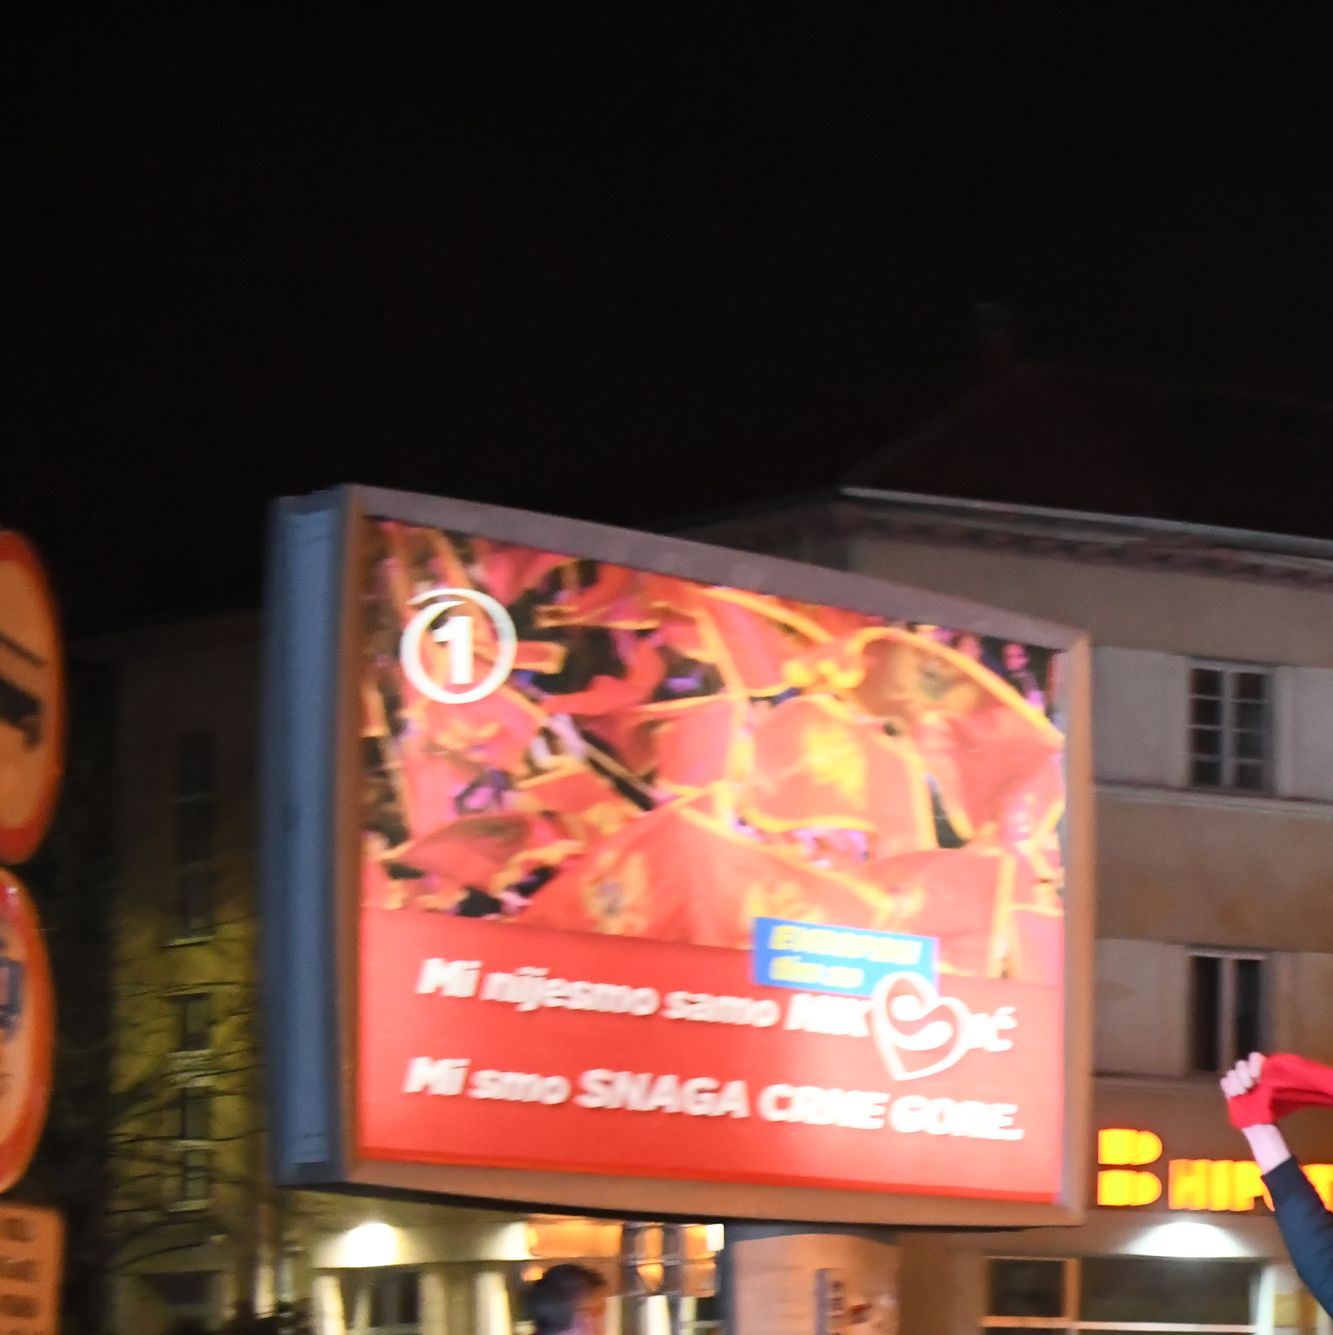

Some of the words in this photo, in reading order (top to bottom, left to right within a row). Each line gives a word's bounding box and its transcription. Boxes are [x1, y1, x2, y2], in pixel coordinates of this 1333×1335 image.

[433, 615, 474, 685] 1
[415, 956, 481, 998] Mi
[663, 989, 781, 1028] samo
[404, 1055, 470, 1096] Mi
[470, 1068, 571, 1106] smo
[576, 1067, 752, 1119] SNAGA
